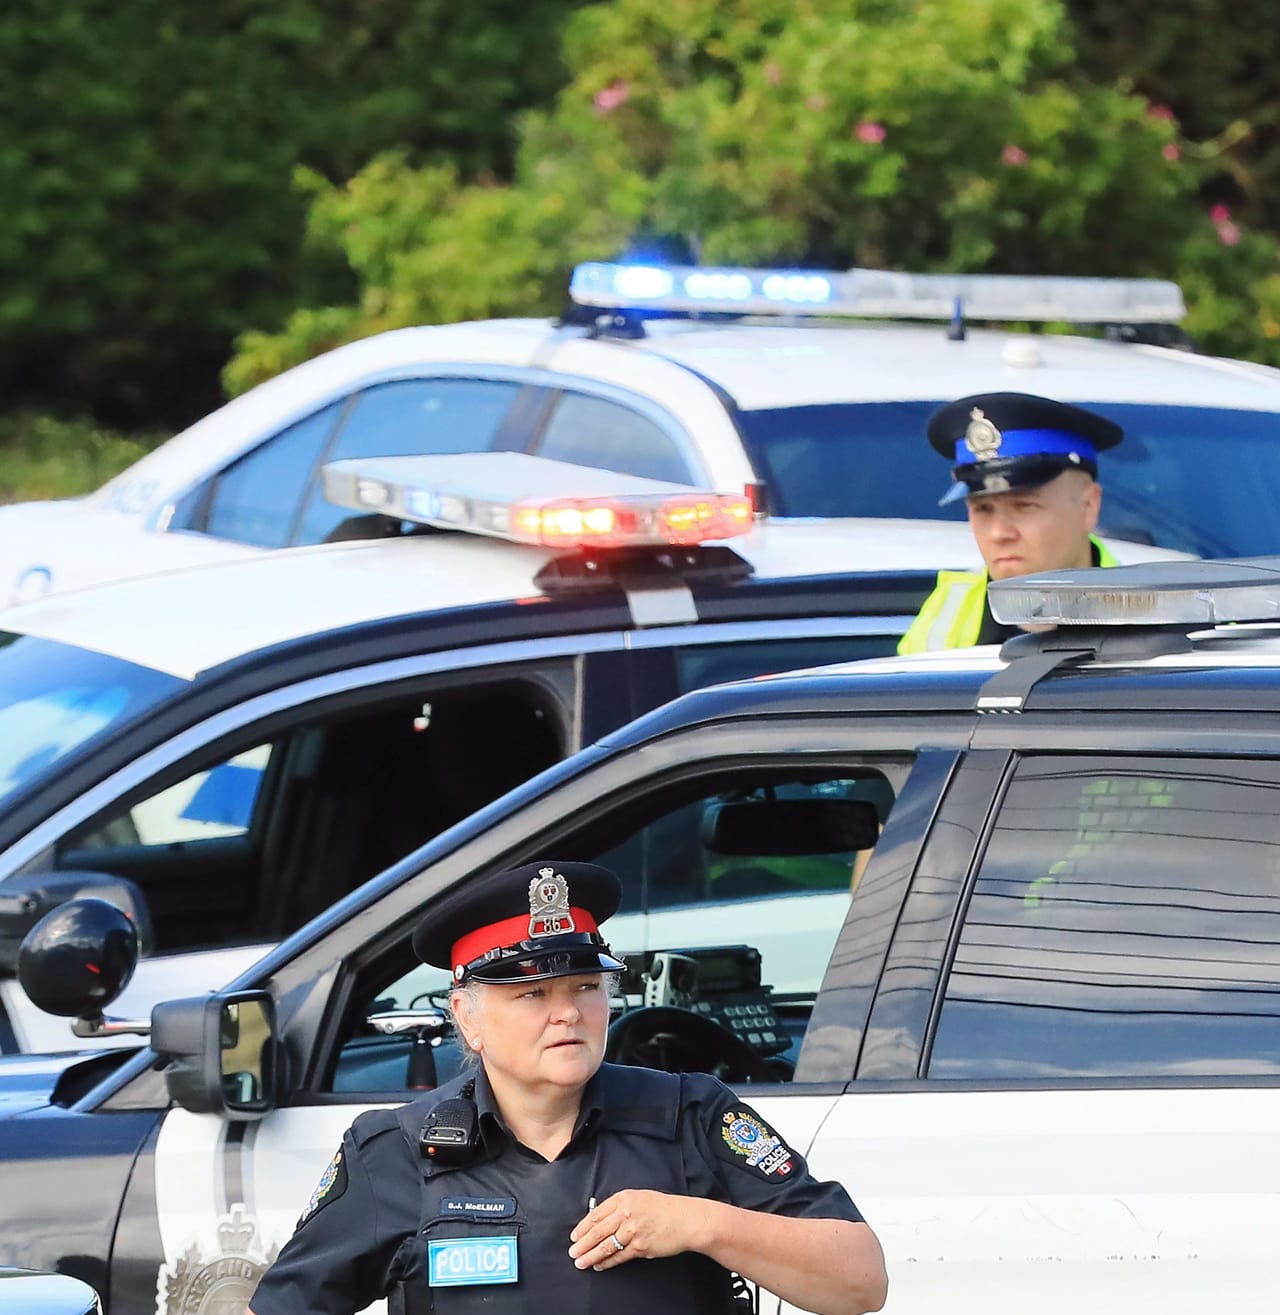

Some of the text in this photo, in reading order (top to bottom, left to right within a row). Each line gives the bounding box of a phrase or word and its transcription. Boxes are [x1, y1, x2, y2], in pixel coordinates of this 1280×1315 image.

[543, 917, 561, 934] 86
[758, 1146, 788, 1173] POLICE
[436, 1245, 510, 1274] POLICE
